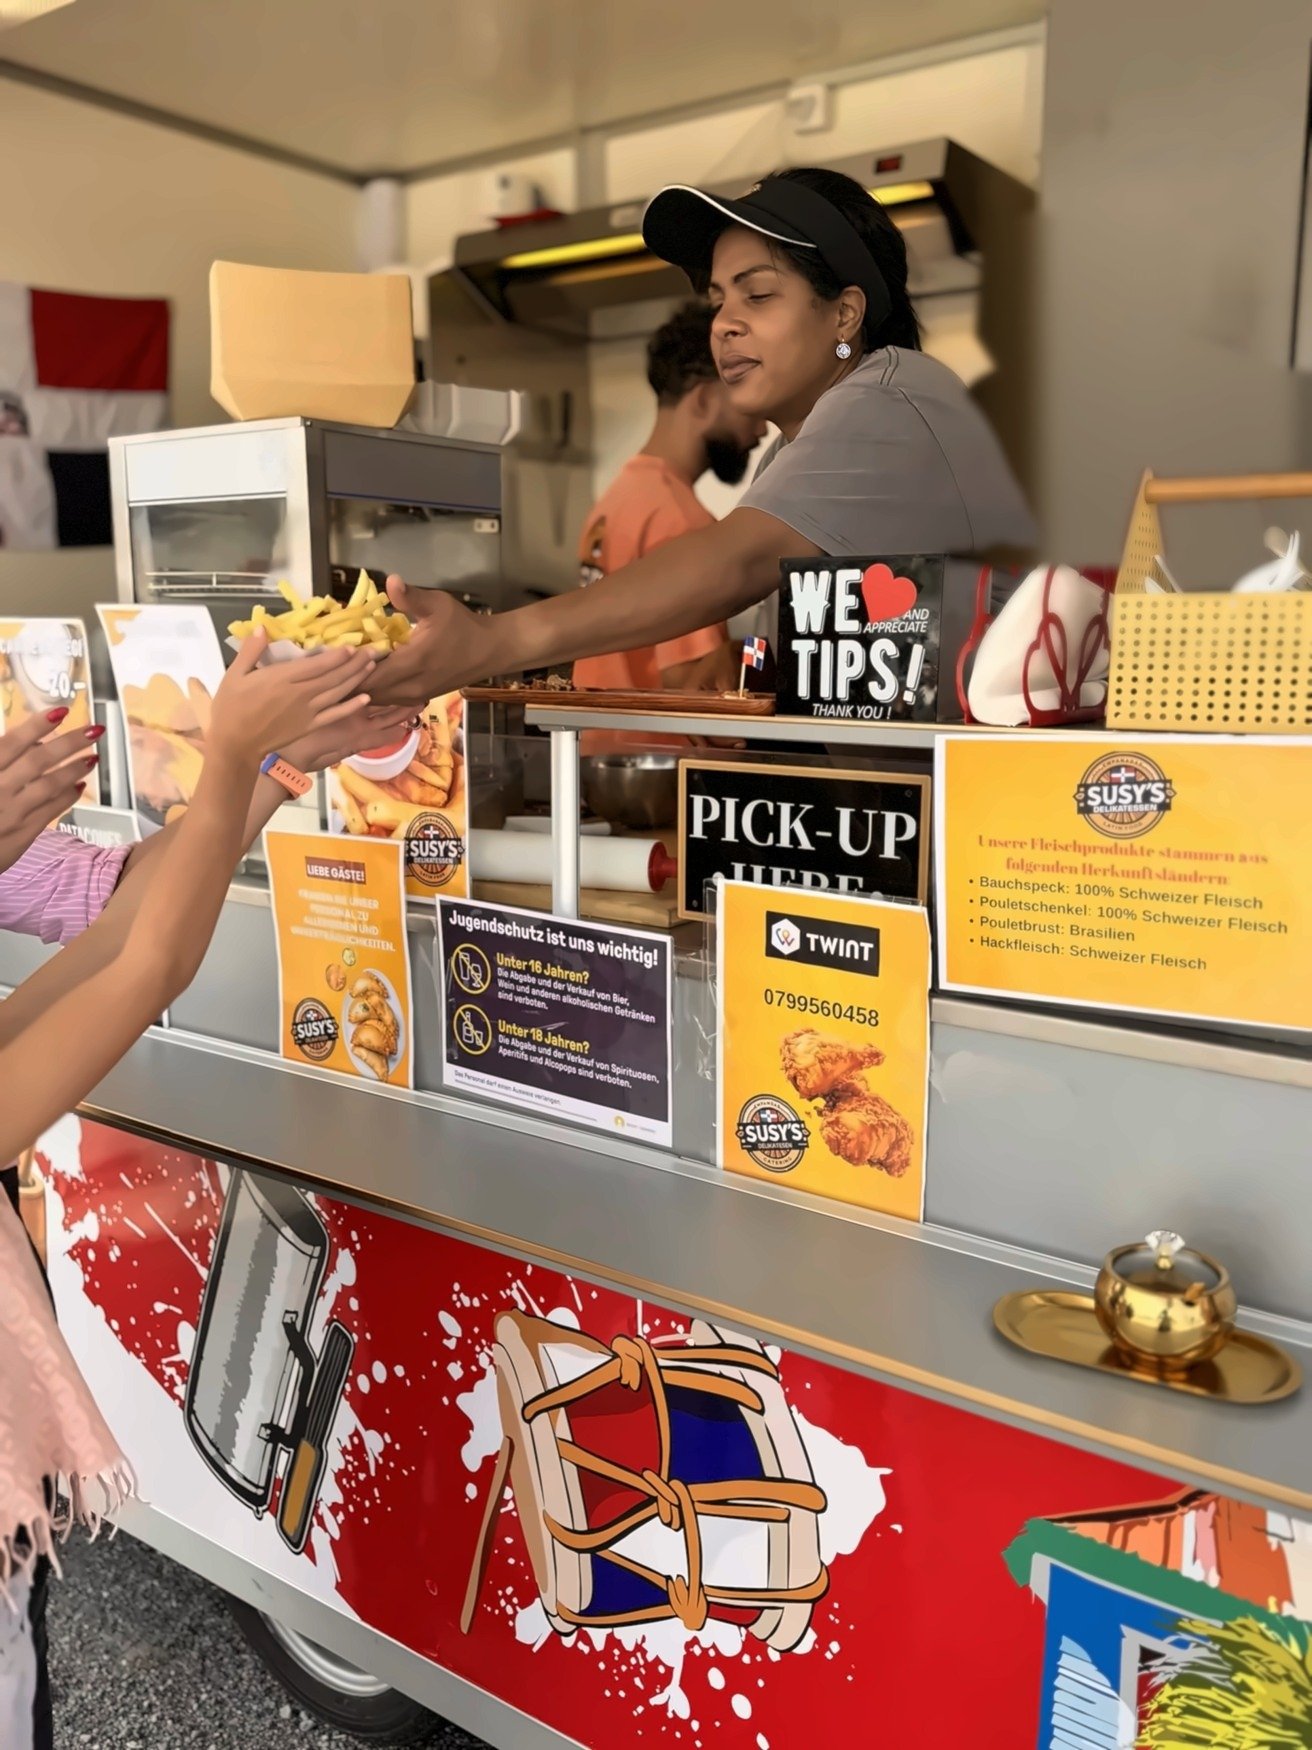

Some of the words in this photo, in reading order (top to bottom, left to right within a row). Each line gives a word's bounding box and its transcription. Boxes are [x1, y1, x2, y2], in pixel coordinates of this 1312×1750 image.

[789, 569, 864, 634] WE
[903, 609, 929, 621] AND
[863, 621, 928, 633] APPRECIATE
[792, 638, 925, 705] TIPS!
[812, 703, 854, 718] THANK
[856, 705, 884, 719] YOU
[1087, 782, 1165, 807] SUSY'S
[1093, 804, 1158, 813] DELIKATESSEN
[689, 794, 917, 860] PICK-UP
[409, 839, 458, 858] SUSY'S
[307, 864, 330, 877] LIEBE
[330, 866, 365, 881] GÄSTE!
[1006, 857, 1079, 875] folgenden
[980, 876, 1070, 894] Bauchspeck:
[1075, 883, 1115, 898] 100%
[1119, 887, 1199, 904] Schweizer
[1204, 893, 1264, 909] Fleisch
[980, 896, 1092, 916] Pouletschenkel:
[1098, 906, 1137, 921] 100%
[1142, 909, 1222, 928] Schweizer
[1228, 917, 1288, 934] Fleisch
[980, 916, 1065, 935] Pouletbrust:
[1070, 924, 1135, 941] Brasilien
[449, 910, 544, 943] Jugendschutz
[546, 928, 567, 947] ist
[568, 936, 595, 953] uns
[596, 940, 658, 969] wichtig!
[806, 933, 874, 961] TWINT
[980, 936, 1065, 955] Hackfleisch:
[1070, 945, 1145, 964] Schweizer
[1150, 953, 1207, 970] Fleisch
[496, 952, 528, 970] Unter
[528, 959, 543, 974] 16
[543, 963, 590, 984] Jahren?
[497, 967, 509, 978] Die
[509, 970, 536, 983] Abgabe
[537, 977, 552, 987] und
[553, 980, 565, 990] der
[566, 983, 595, 997] Verkauf
[596, 991, 611, 1001] von
[612, 993, 630, 1006] Bier,
[497, 990, 513, 1001] sind
[513, 994, 548, 1010] verboten.
[497, 979, 515, 990] Wein
[516, 983, 530, 994] und
[531, 987, 561, 1001] anderen
[562, 995, 613, 1014] alkoholischen
[614, 1005, 656, 1023] Getränken
[764, 988, 879, 1027] 0799560458
[297, 1019, 335, 1039] SUSY'S
[498, 1019, 528, 1038] Unter
[529, 1028, 543, 1042] 18
[544, 1032, 590, 1054] Jahren?
[498, 1034, 510, 1045] Die
[510, 1037, 537, 1052] Abgabe
[537, 1045, 551, 1056] und
[553, 1048, 565, 1059] der
[566, 1052, 595, 1067] Verkauf
[595, 1060, 610, 1071] von
[611, 1063, 660, 1084] Spirituosen,
[498, 1045, 529, 1061] Aperitifs
[529, 1055, 543, 1066] und
[544, 1056, 577, 1075] Alcopops
[577, 1067, 594, 1079] sind
[595, 1071, 632, 1088] verboten.
[745, 1122, 803, 1143] SUSY'S
